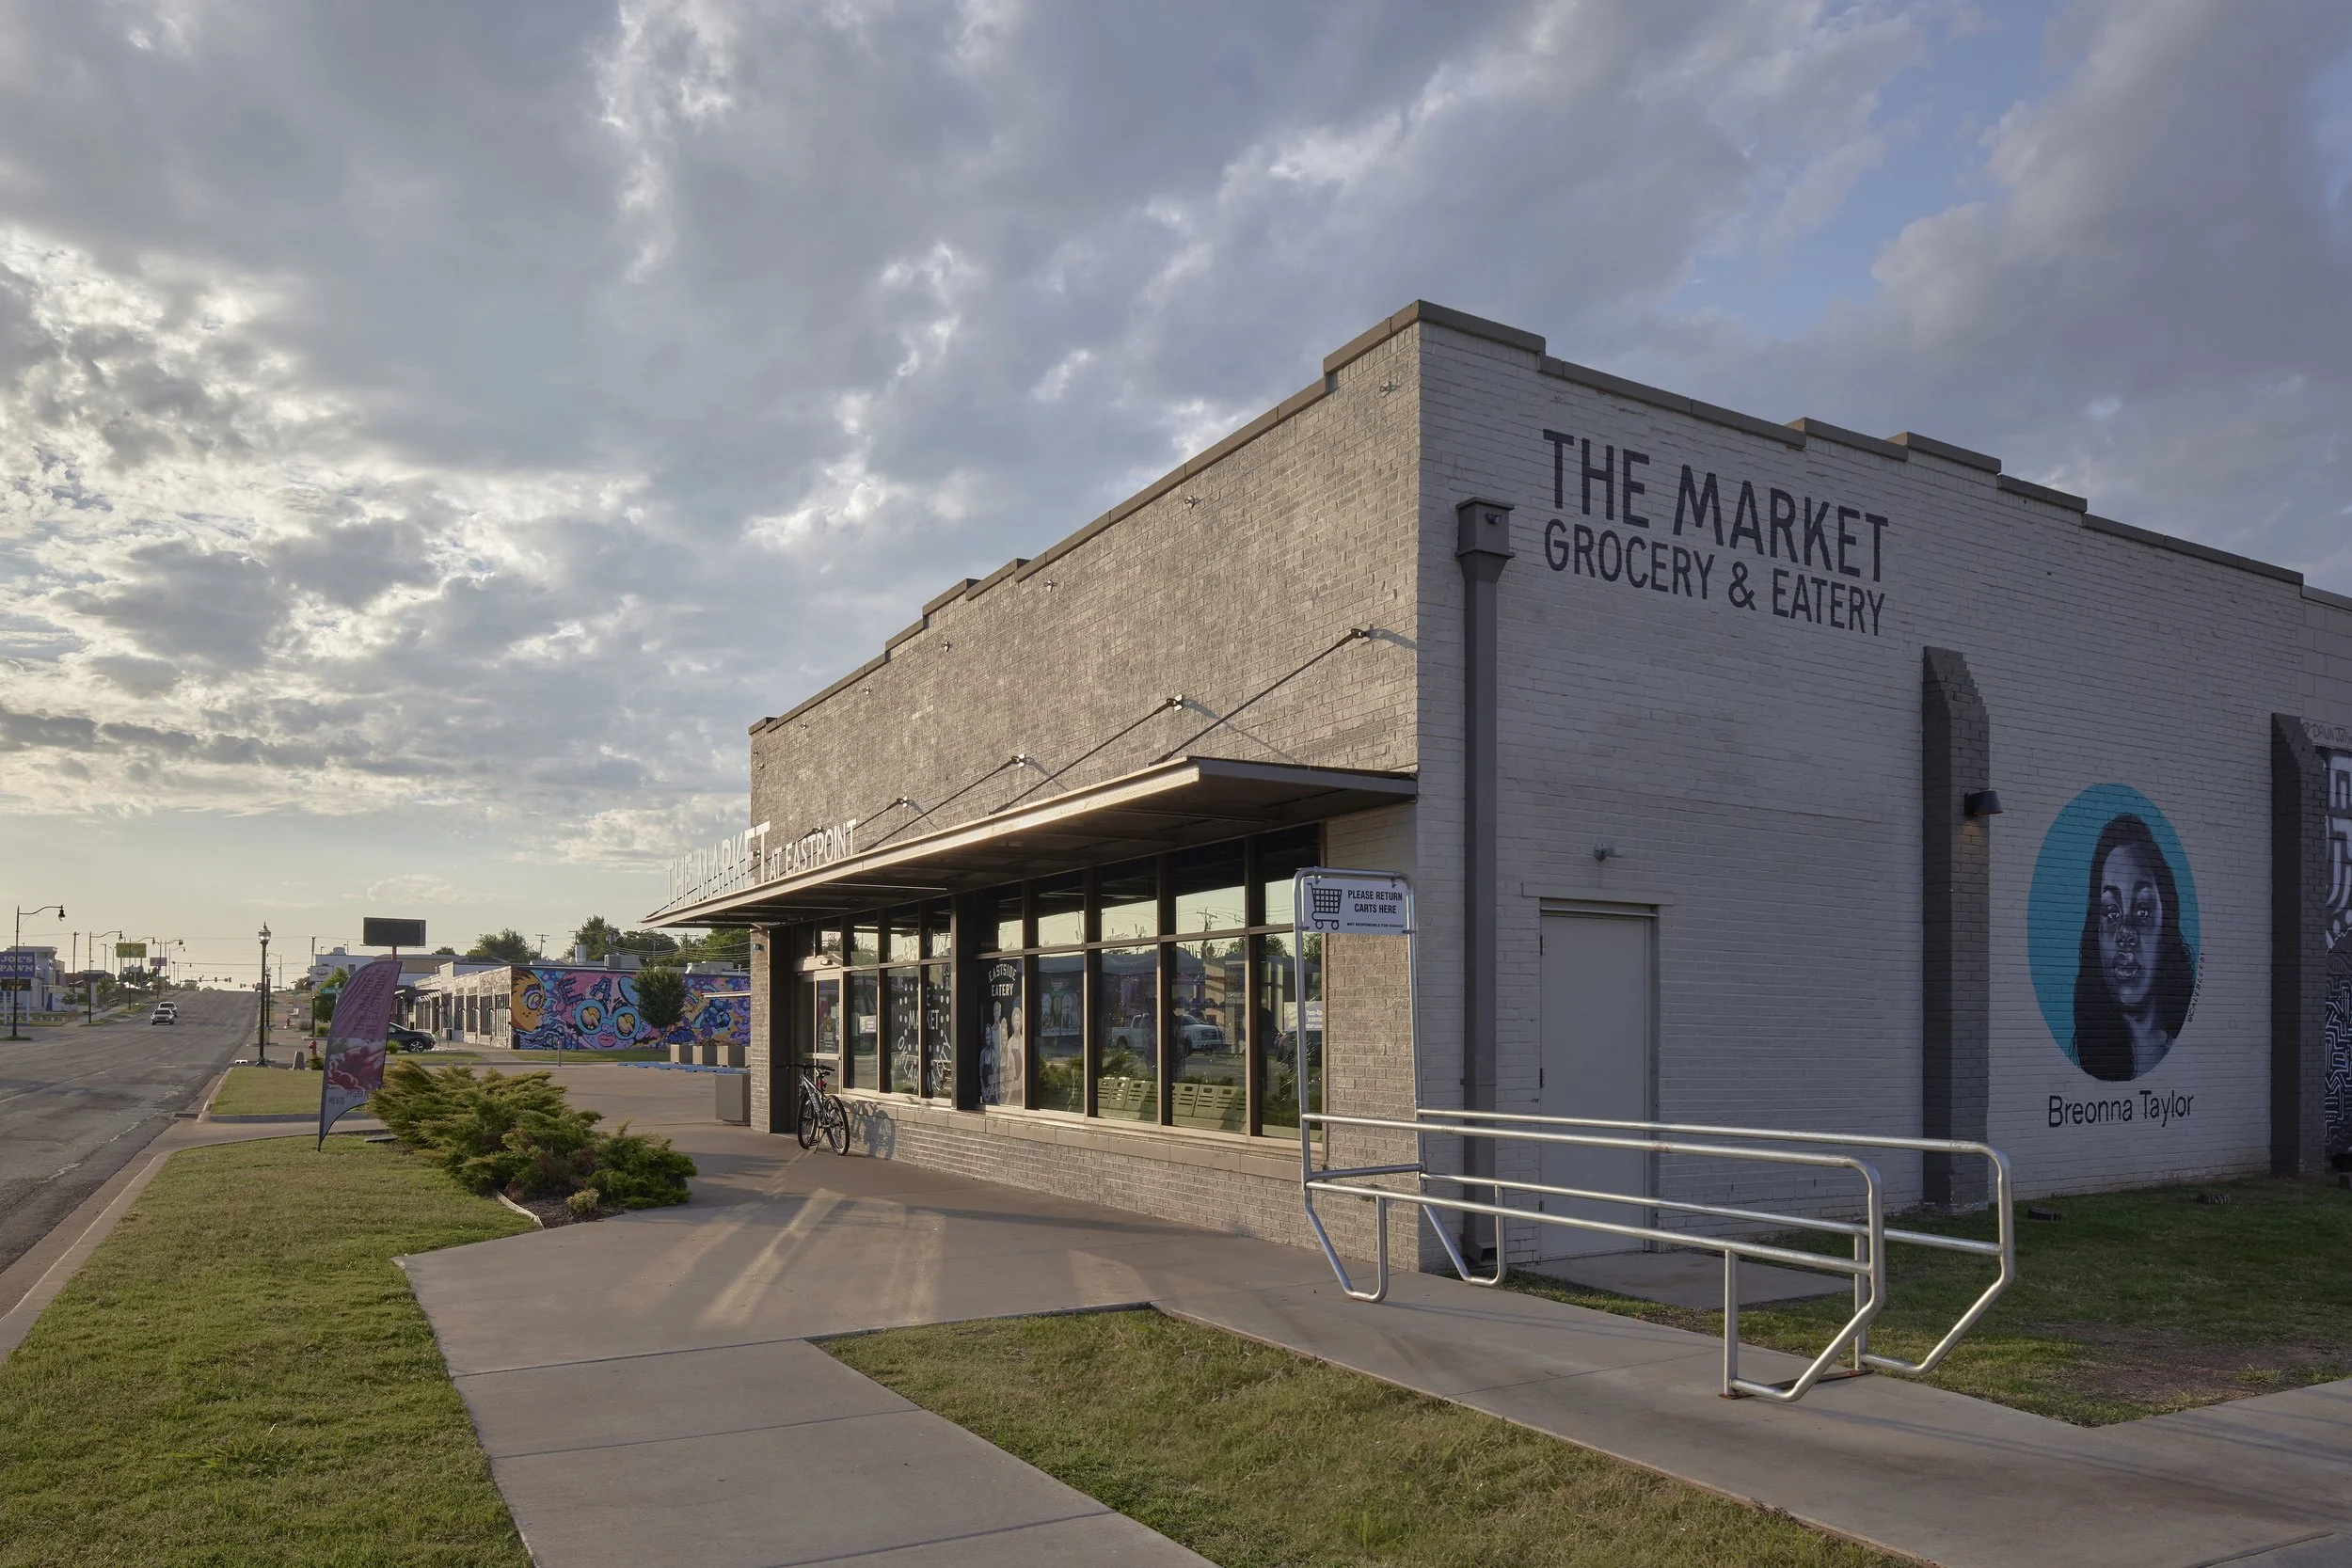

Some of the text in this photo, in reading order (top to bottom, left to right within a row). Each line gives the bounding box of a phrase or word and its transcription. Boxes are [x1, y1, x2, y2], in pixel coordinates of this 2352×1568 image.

[1543, 428, 1889, 583] THE MARKET
[1544, 518, 1885, 637] GROCERY & EATERY
[665, 818, 857, 911] THE MARKET AT EASTPOINT
[1347, 889, 1403, 901] PLEASE RETURN
[1354, 903, 1397, 914] CARTS HERE
[989, 963, 1017, 983] EASTSIDE
[991, 983, 1014, 997] EATERY
[908, 1009, 939, 1030] MAKET
[328, 1096, 345, 1104] MEATS
[2048, 1089, 2195, 1128] Breonna Taylor
